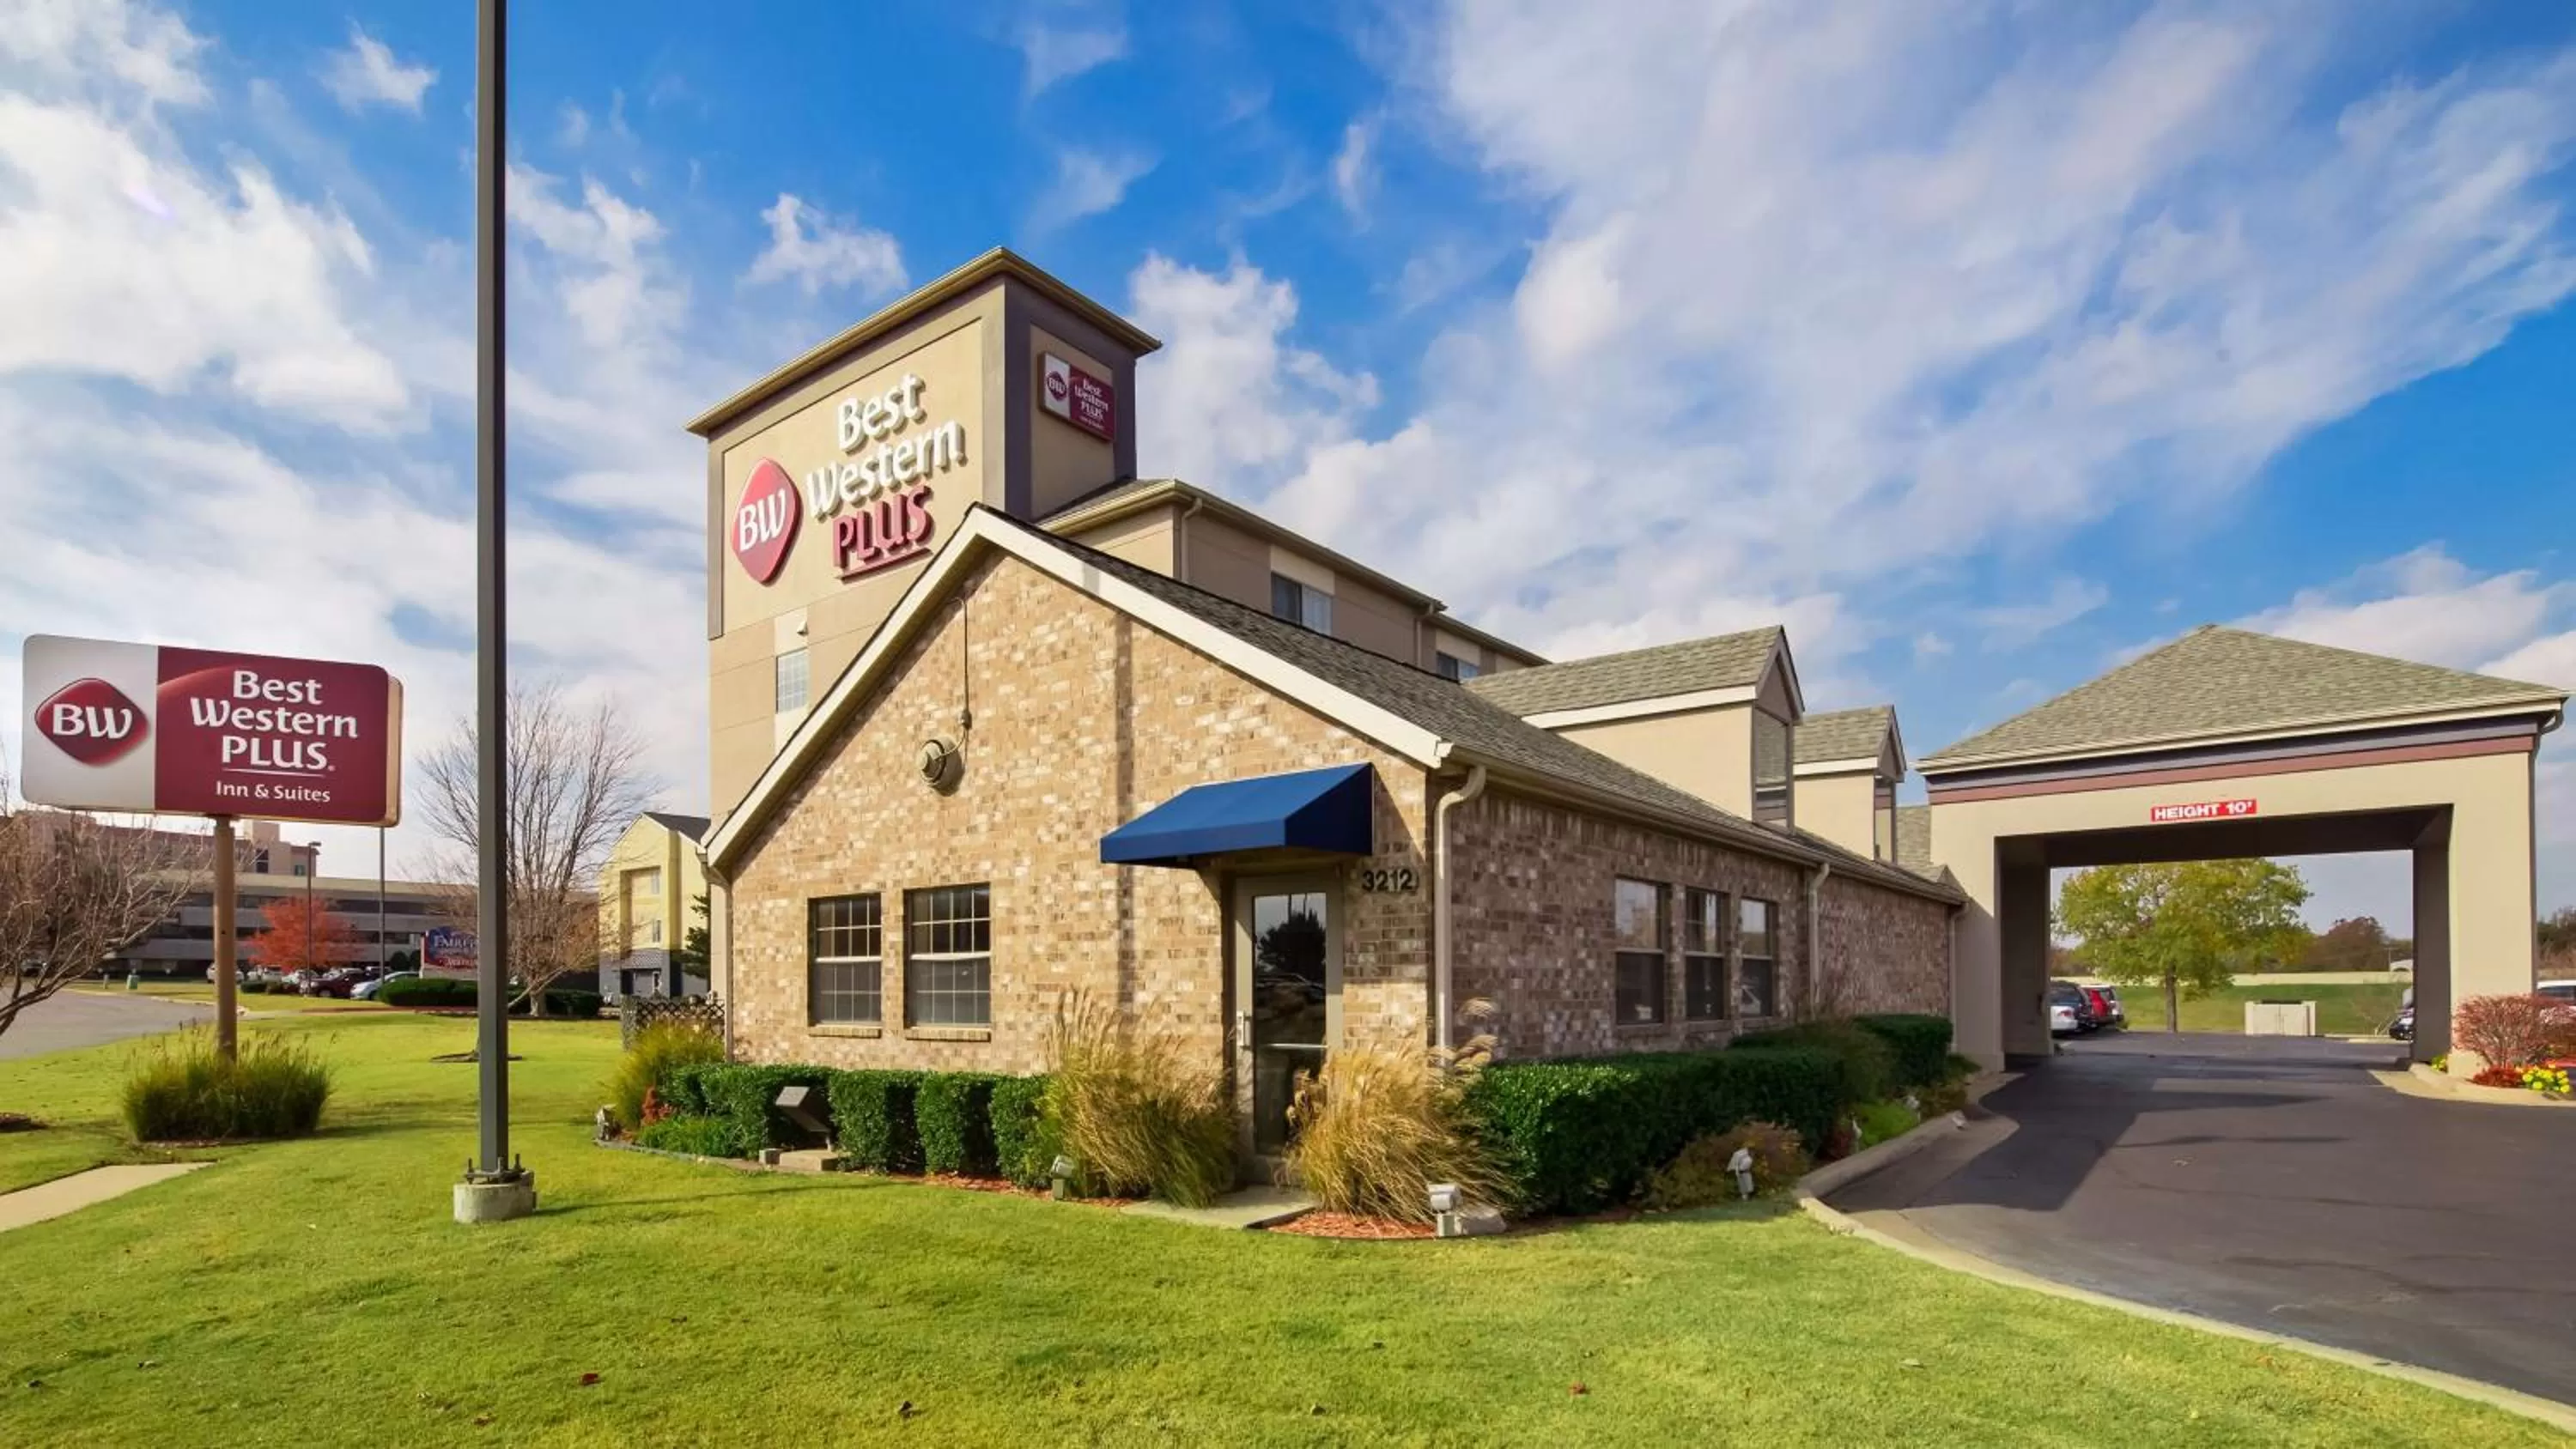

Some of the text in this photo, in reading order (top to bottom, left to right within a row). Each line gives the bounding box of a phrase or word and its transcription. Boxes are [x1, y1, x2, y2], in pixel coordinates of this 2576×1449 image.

[837, 373, 927, 452] Best
[805, 420, 967, 519] Western
[738, 488, 787, 552] BW
[832, 485, 933, 568] PLUS
[233, 670, 324, 706] Best
[52, 702, 133, 740] BW
[190, 697, 358, 739] Western
[216, 780, 331, 803] Inn & Suites
[2154, 803, 2220, 820] HEIGHT
[1362, 869, 1413, 892] 3212
